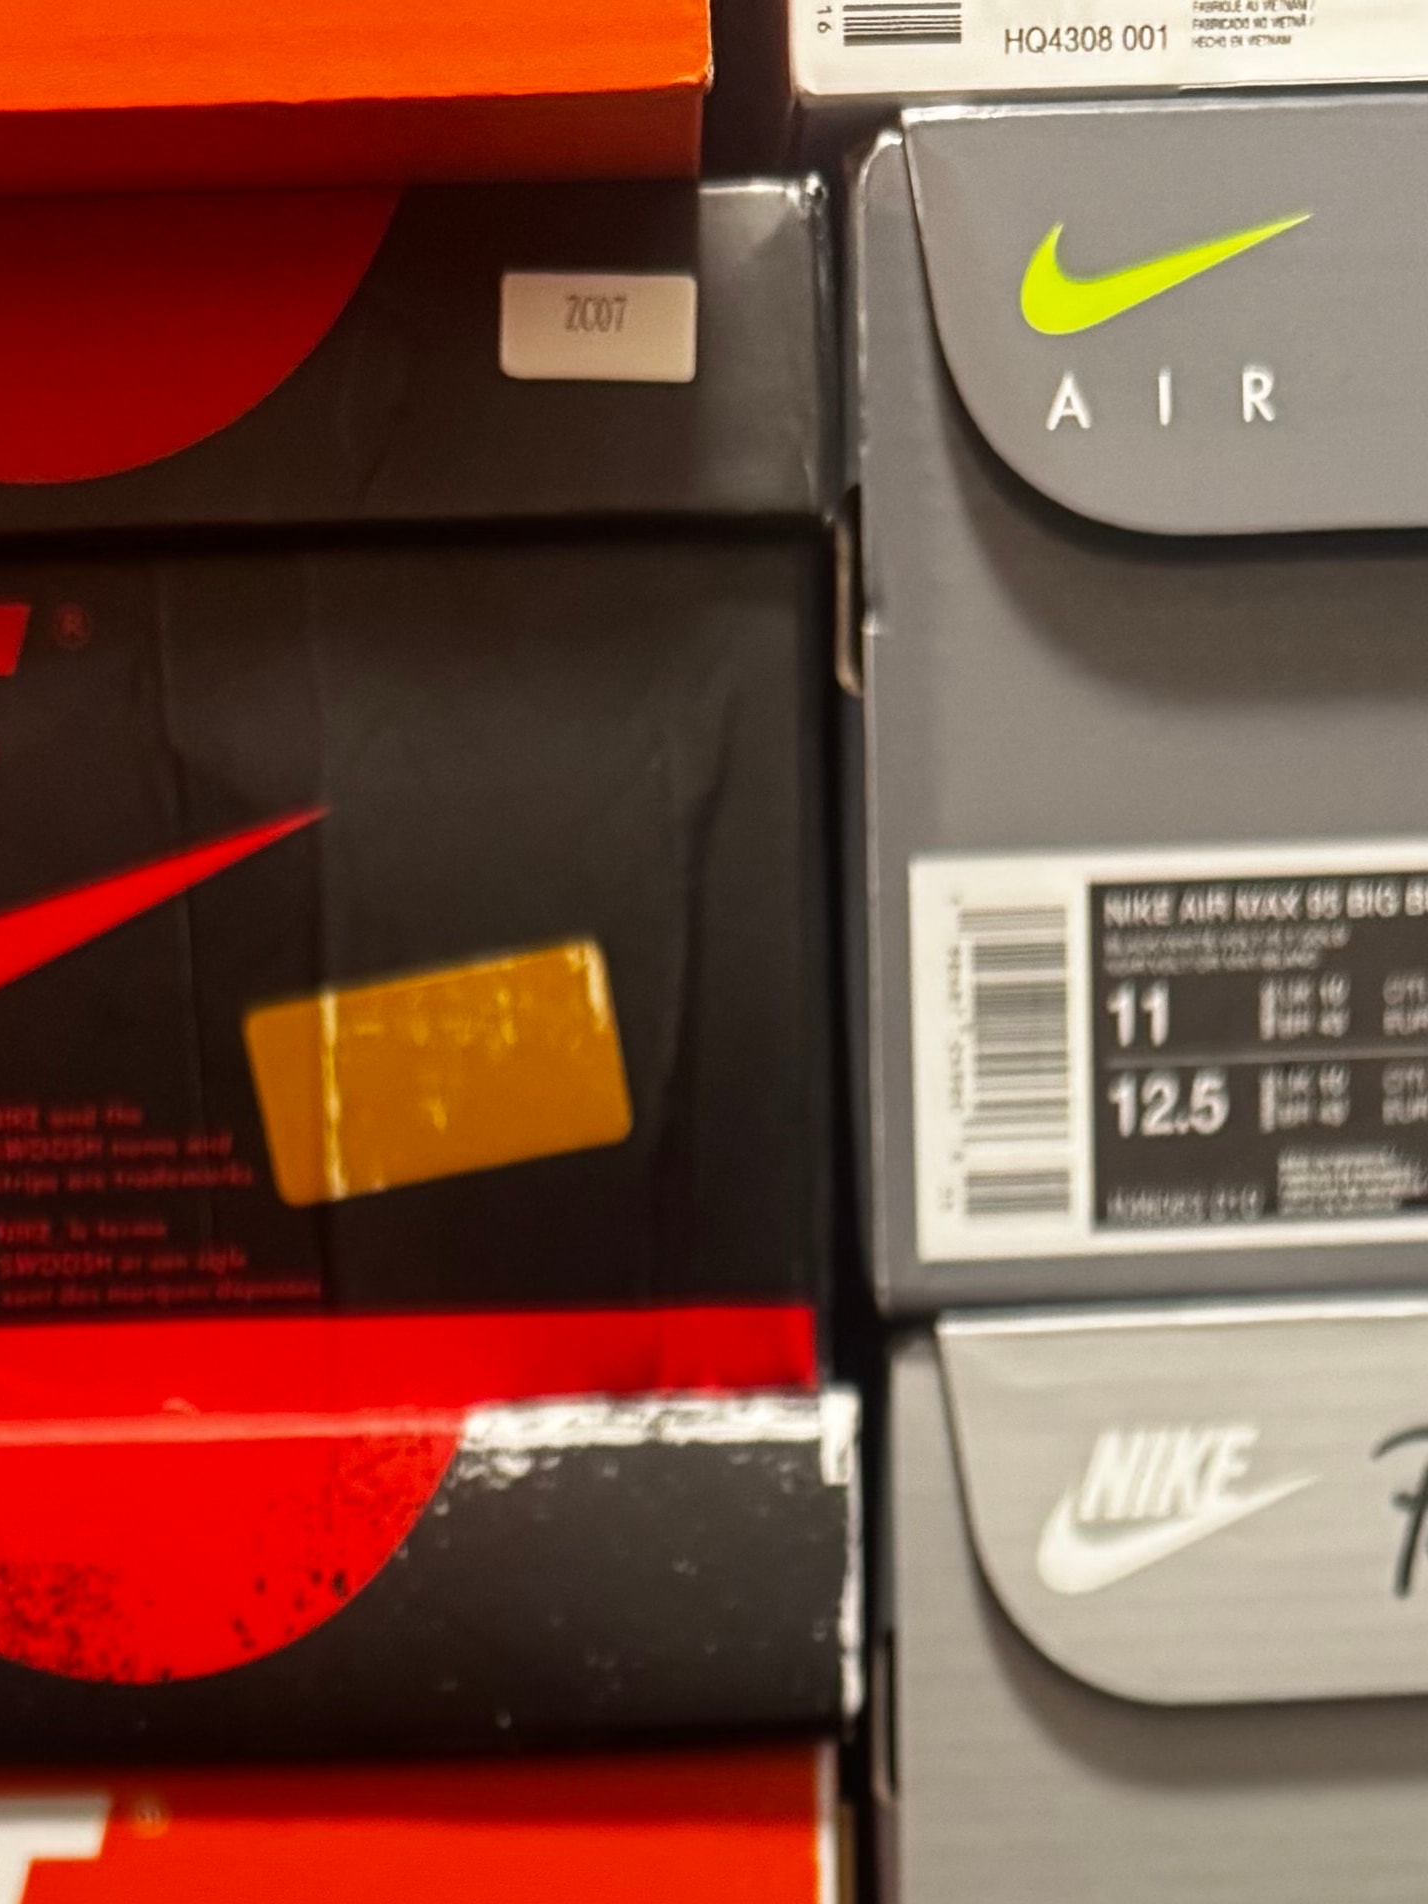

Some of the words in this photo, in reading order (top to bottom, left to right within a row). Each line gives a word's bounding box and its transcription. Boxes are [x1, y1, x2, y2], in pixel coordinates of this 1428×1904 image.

[1005, 26, 1113, 54] HQ4308
[1123, 25, 1169, 51] 001
[1045, 363, 1276, 430] AIR
[1103, 888, 1172, 926] NIKE
[1178, 885, 1231, 923] AIR
[1234, 882, 1304, 921] MAX
[1347, 879, 1401, 918] BIG
[1106, 982, 1170, 1048] 11
[1107, 1068, 1230, 1137] 12.5
[1078, 1426, 1261, 1522] NIKE
